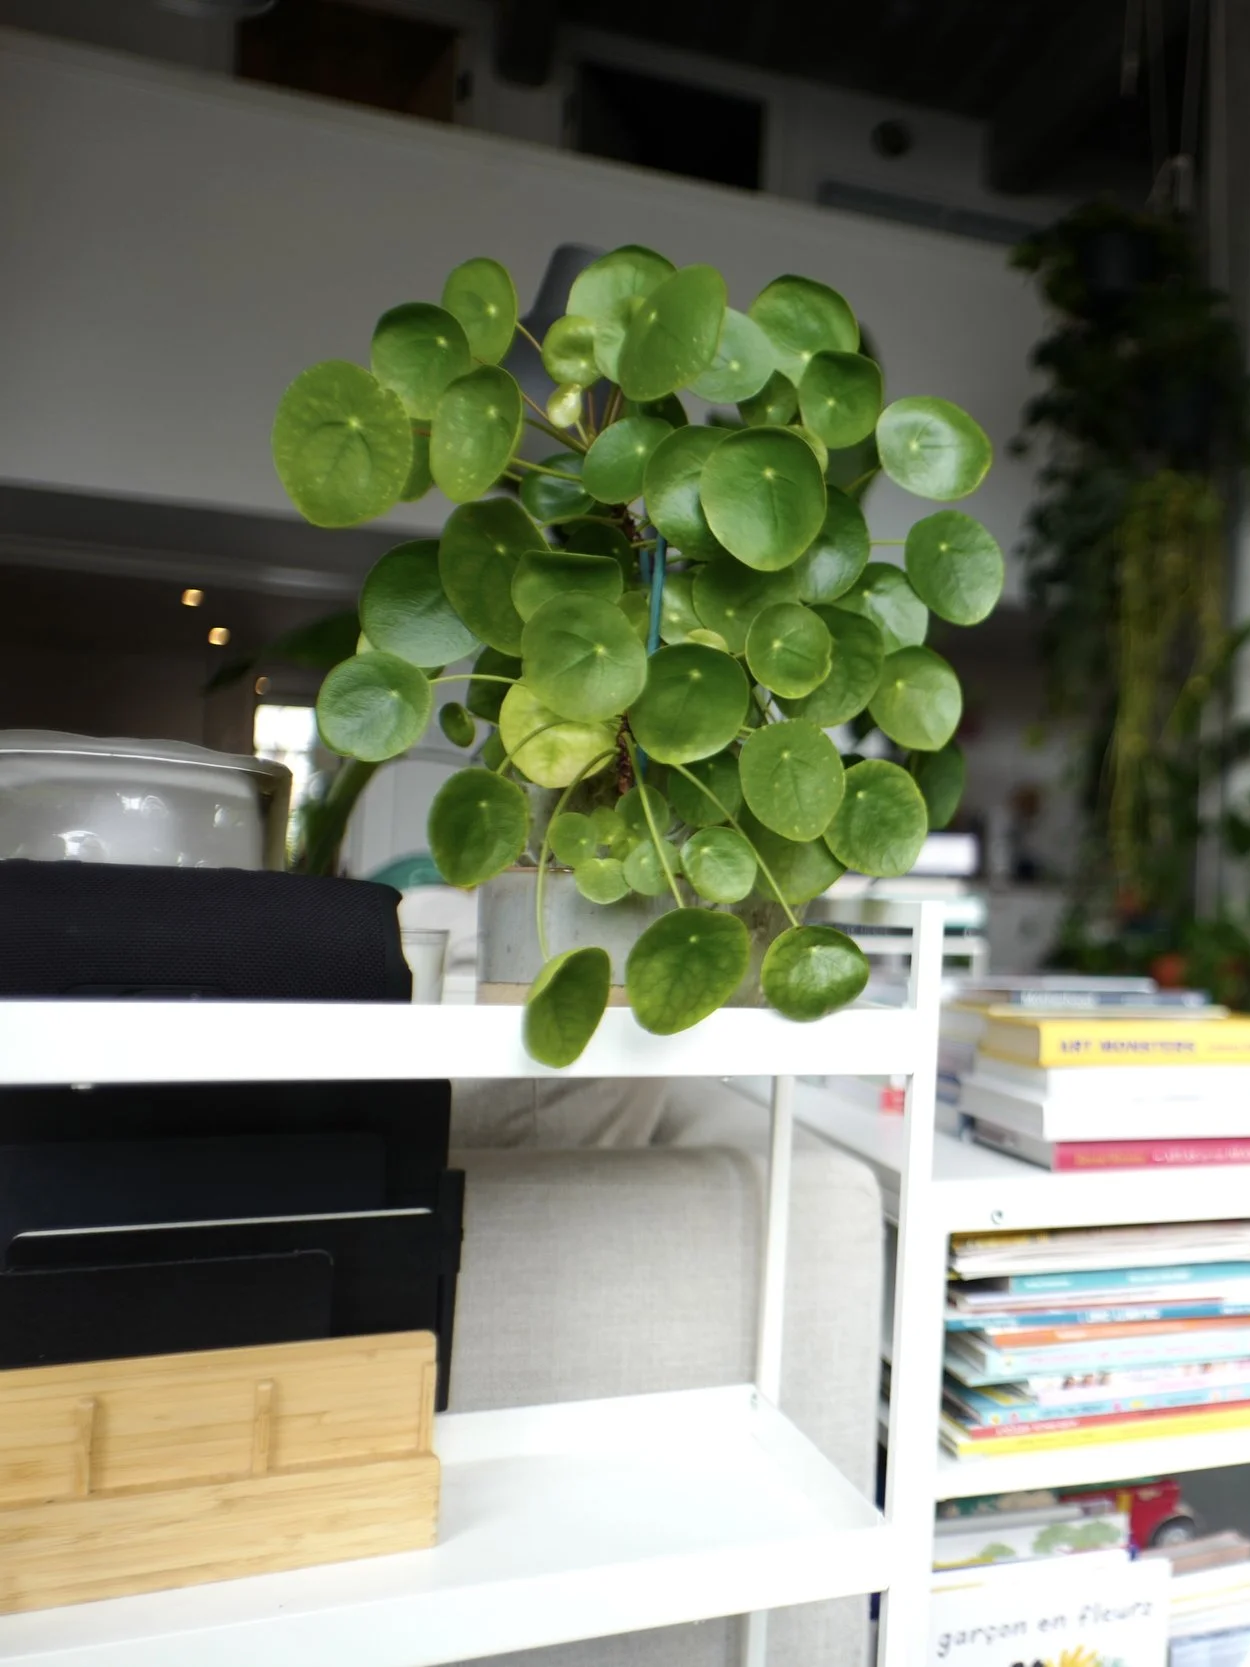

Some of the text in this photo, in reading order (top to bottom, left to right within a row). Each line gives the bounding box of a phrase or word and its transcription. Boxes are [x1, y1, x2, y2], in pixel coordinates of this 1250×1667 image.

[936, 1601, 1152, 1659] garçon en fleurs
